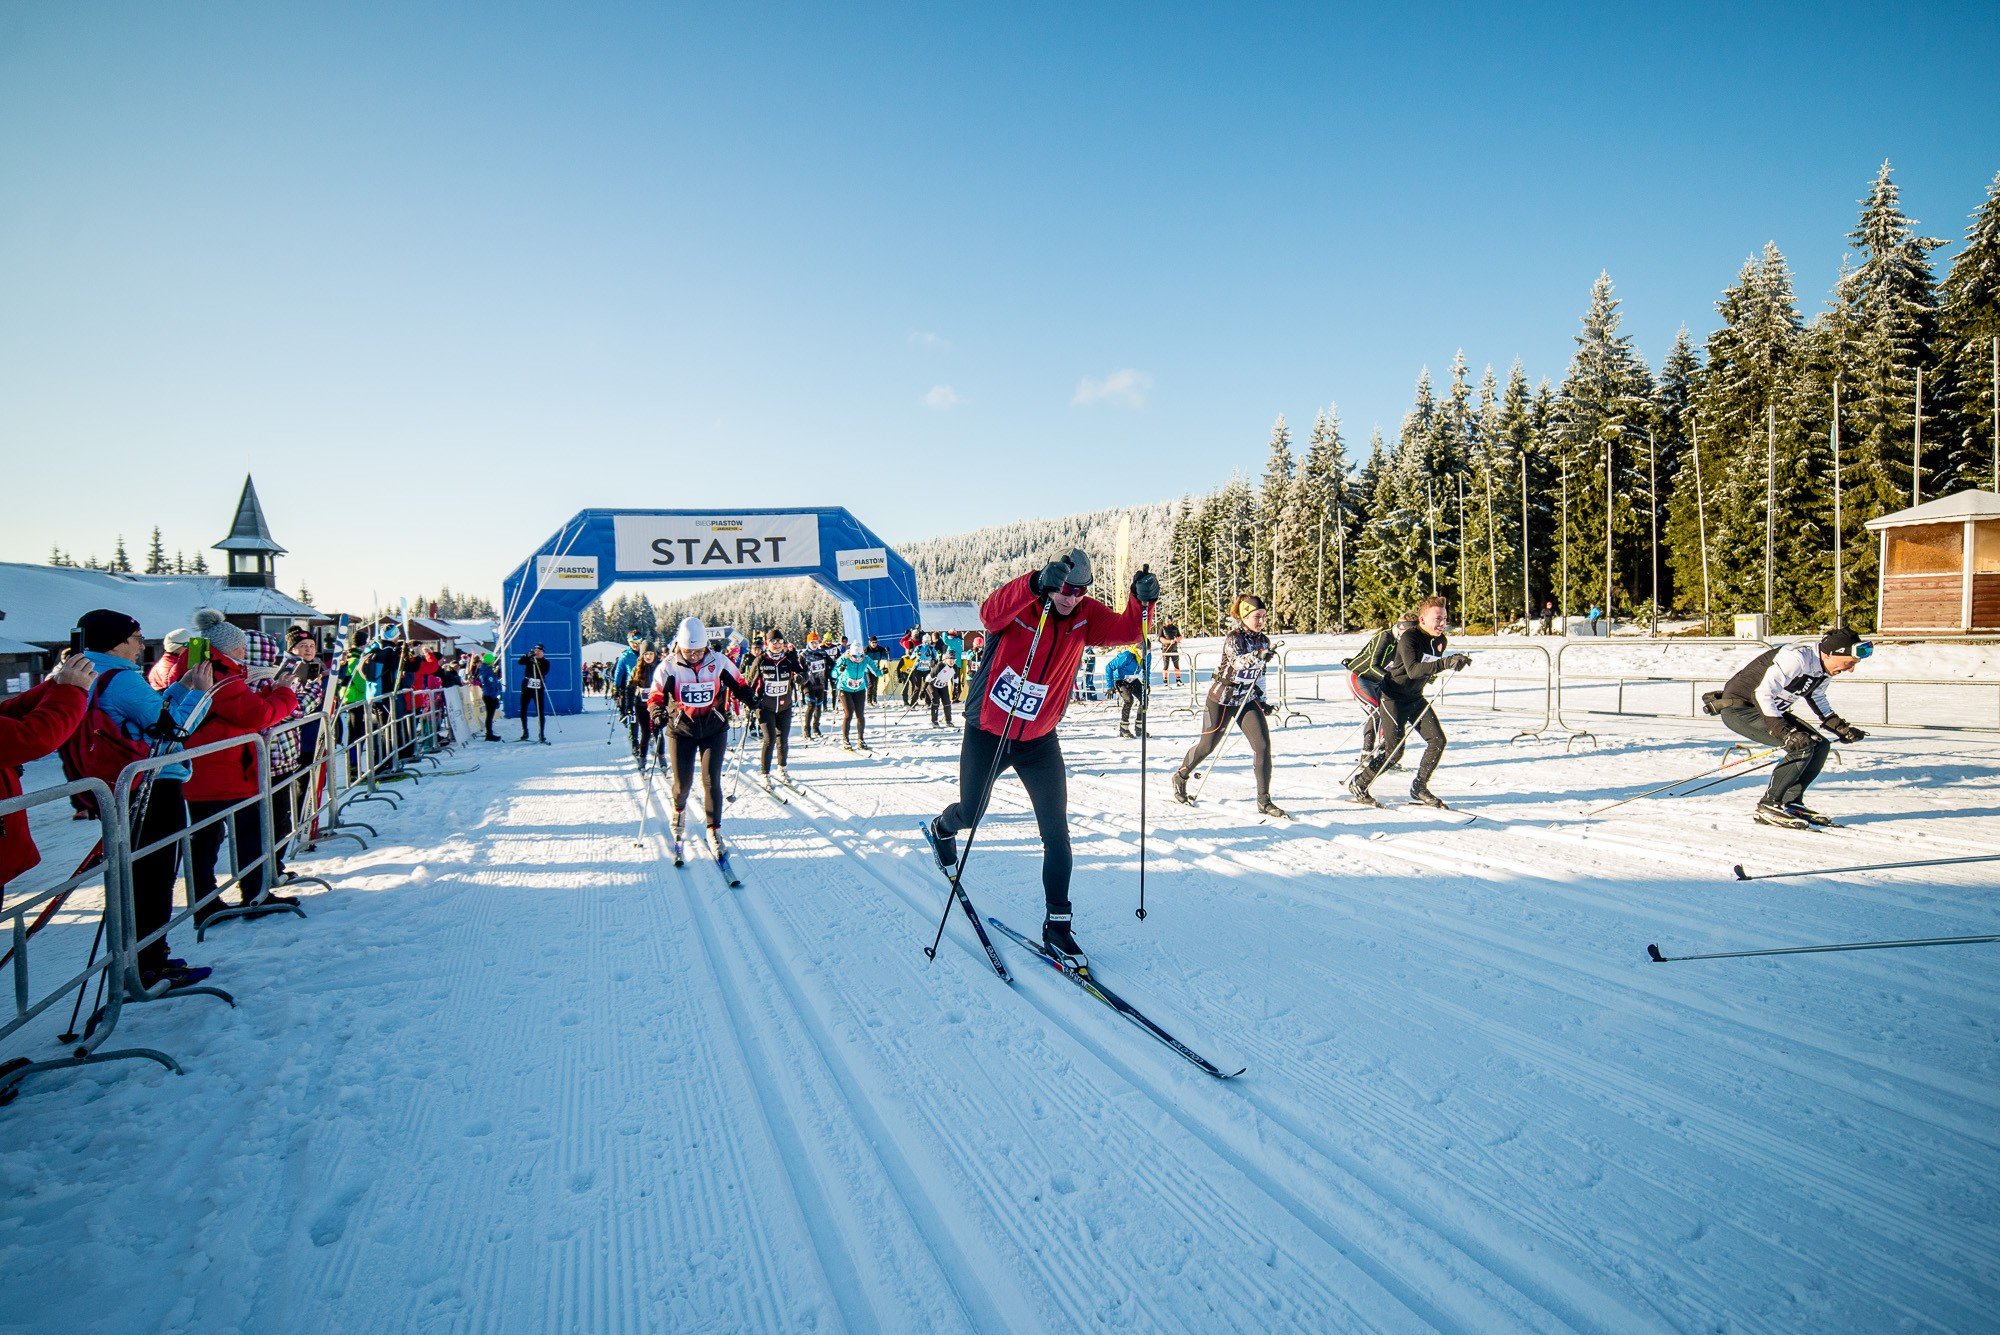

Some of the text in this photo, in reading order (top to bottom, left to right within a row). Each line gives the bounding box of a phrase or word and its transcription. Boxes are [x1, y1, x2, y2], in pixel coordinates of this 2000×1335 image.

[651, 537, 786, 565] START
[684, 691, 711, 702] 133
[997, 683, 1038, 713] 338
[985, 945, 1002, 969] salomon
[1168, 1039, 1204, 1063] salomon
